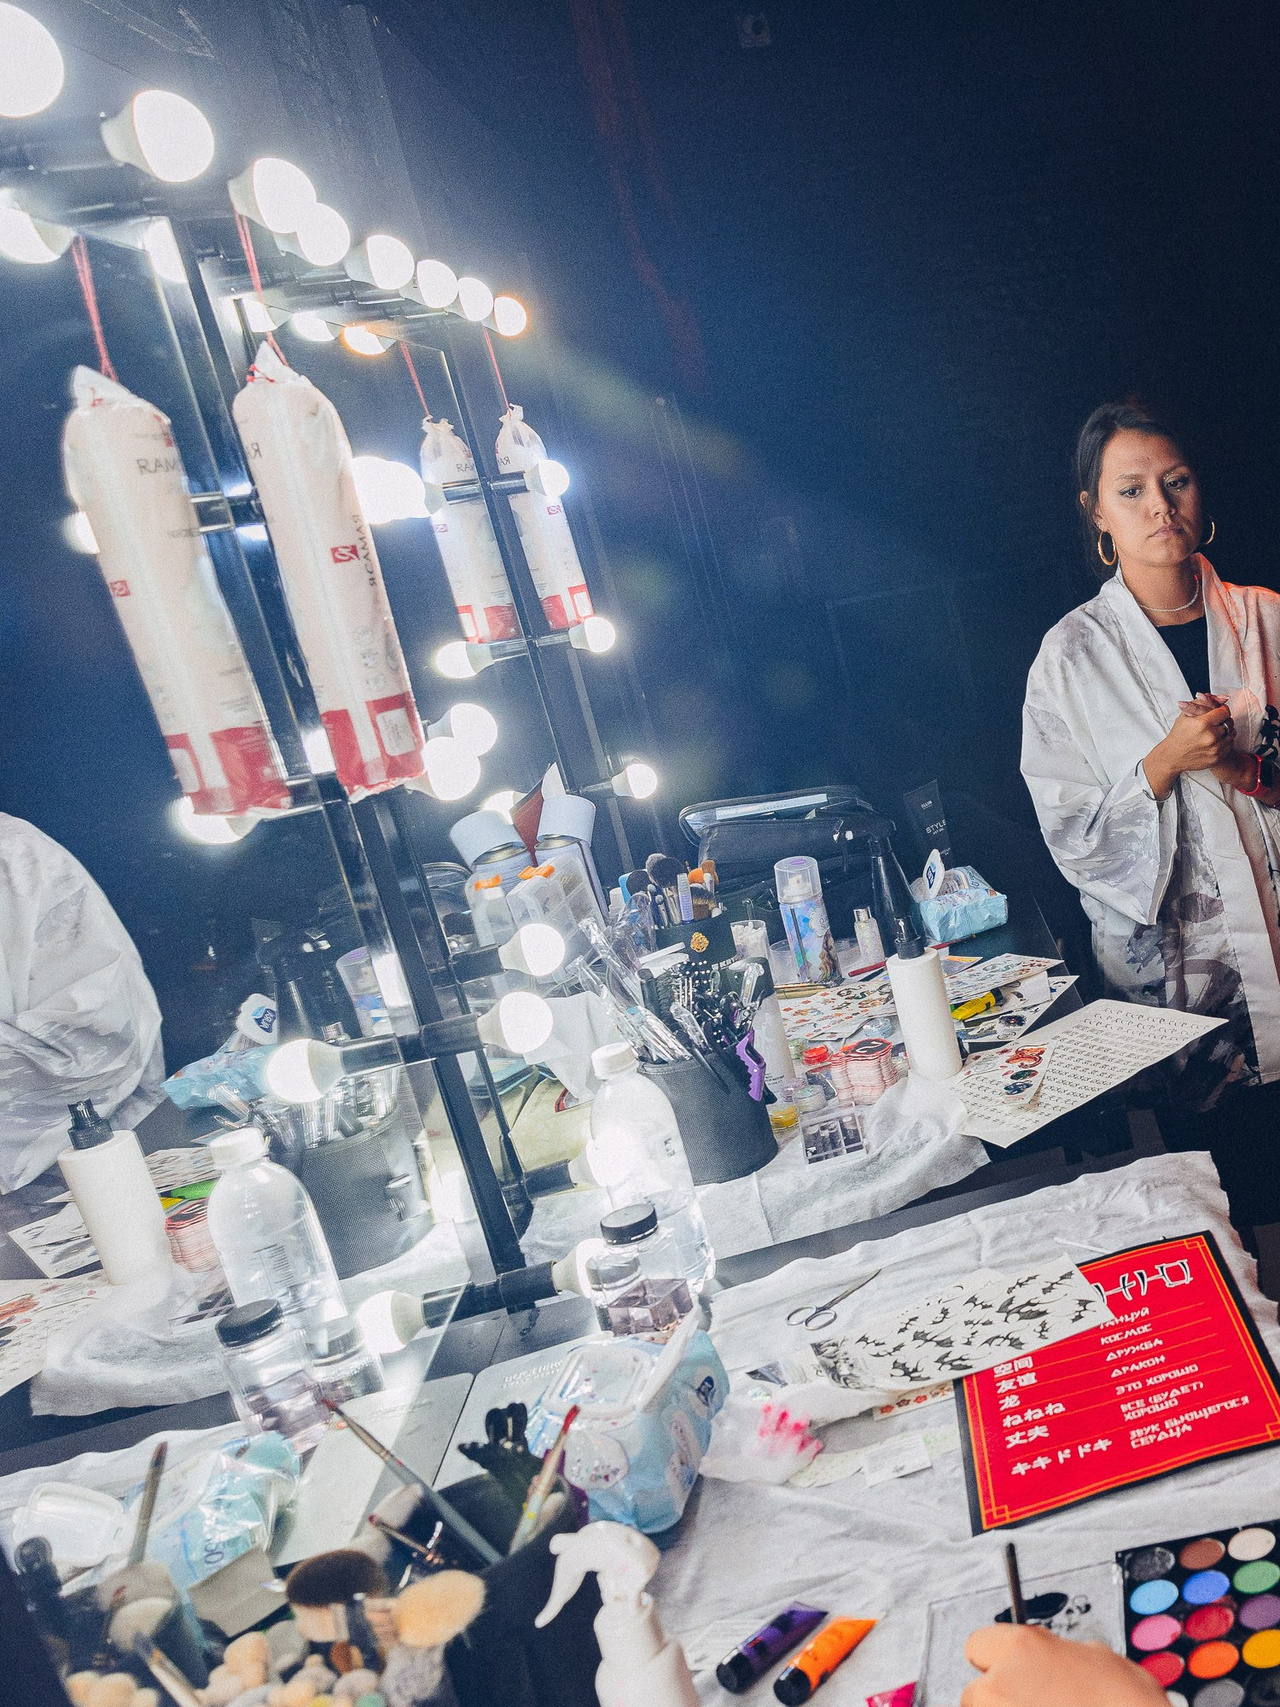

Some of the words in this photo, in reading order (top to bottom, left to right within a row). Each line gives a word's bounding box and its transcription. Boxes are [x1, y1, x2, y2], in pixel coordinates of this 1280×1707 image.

[1101, 1323, 1153, 1346] КОСМОС
[1106, 1338, 1164, 1361] ДРУЖБА
[993, 1355, 1034, 1378] 空间
[1110, 1354, 1166, 1378] ДРАКОН
[995, 1372, 1038, 1394] 友谊
[1115, 1380, 1143, 1395] ЭТО
[1145, 1364, 1199, 1387] ХОРОШО
[999, 1394, 1021, 1411] 龙
[1123, 1398, 1179, 1422] ХОРОШО
[1002, 1402, 1066, 1428] ねねね
[1005, 1425, 1050, 1449] 丈夫
[1129, 1423, 1161, 1440] ЗВУК
[1130, 1423, 1193, 1449] СЕРДЦА
